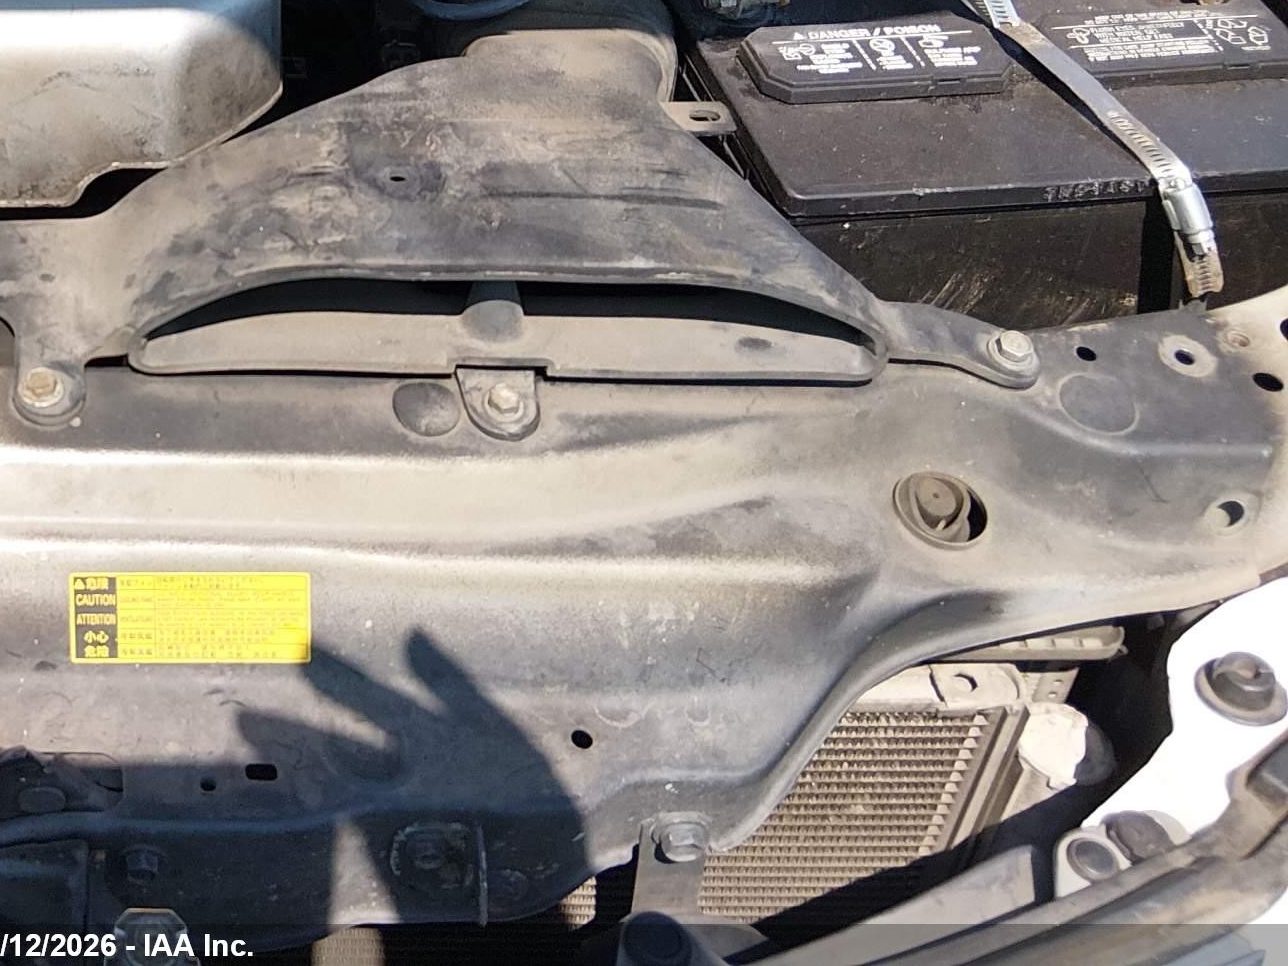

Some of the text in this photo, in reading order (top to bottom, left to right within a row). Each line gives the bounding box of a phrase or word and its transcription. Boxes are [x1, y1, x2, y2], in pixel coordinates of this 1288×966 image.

[808, 28, 871, 40] DANGER
[883, 24, 941, 35] POISON
[75, 594, 116, 606] CAUTION
[76, 613, 117, 625] ATTENTION
